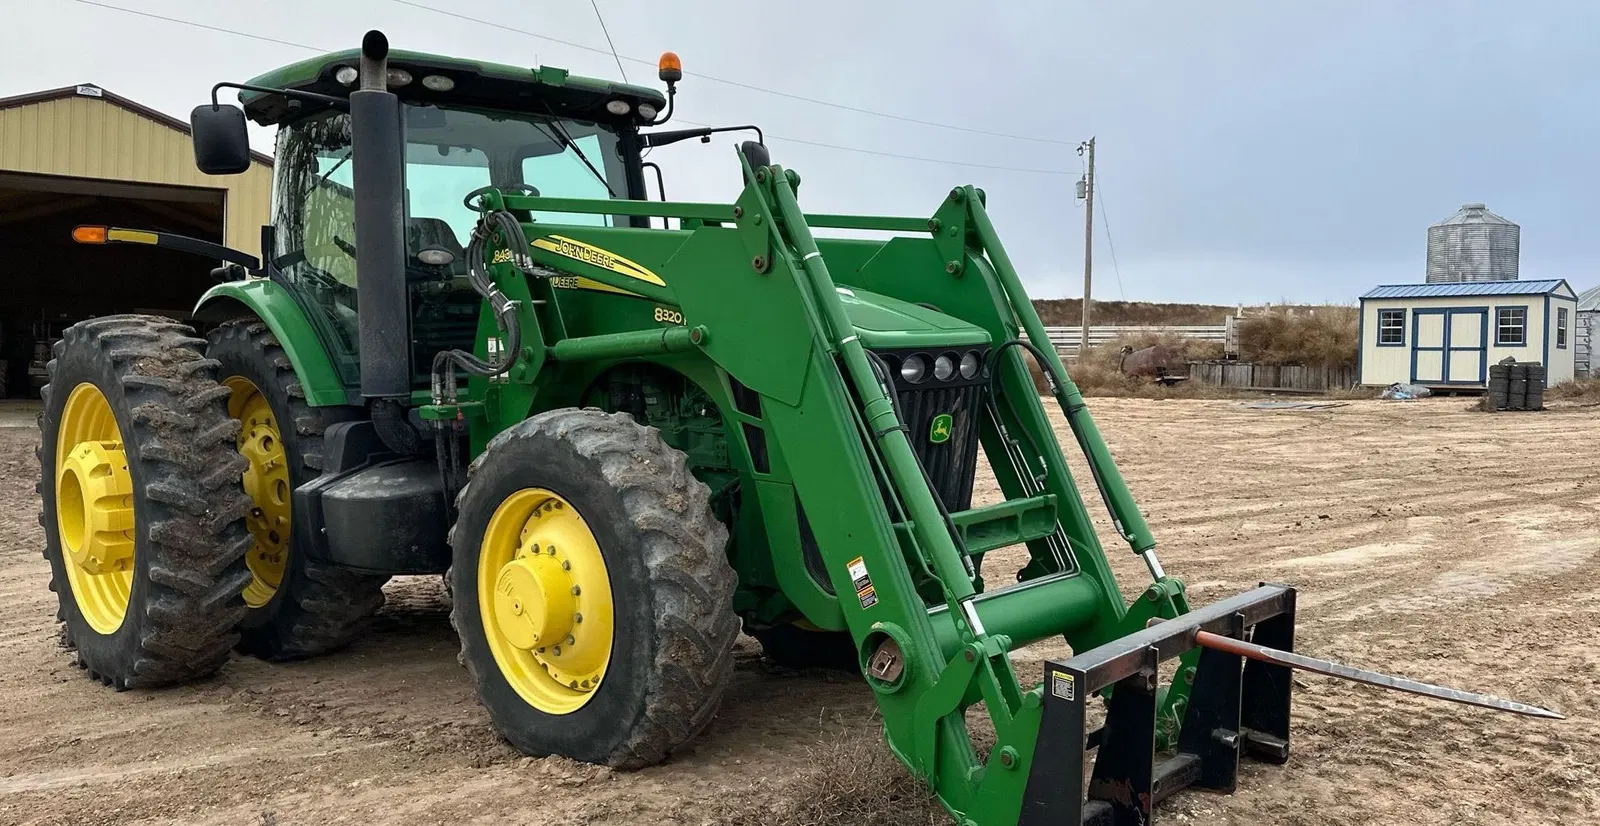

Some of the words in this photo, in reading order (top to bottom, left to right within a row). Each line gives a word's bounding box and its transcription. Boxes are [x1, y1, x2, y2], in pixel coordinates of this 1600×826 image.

[555, 239, 583, 259] JOHN
[583, 246, 614, 269] DEERE
[654, 307, 687, 326] 8320
